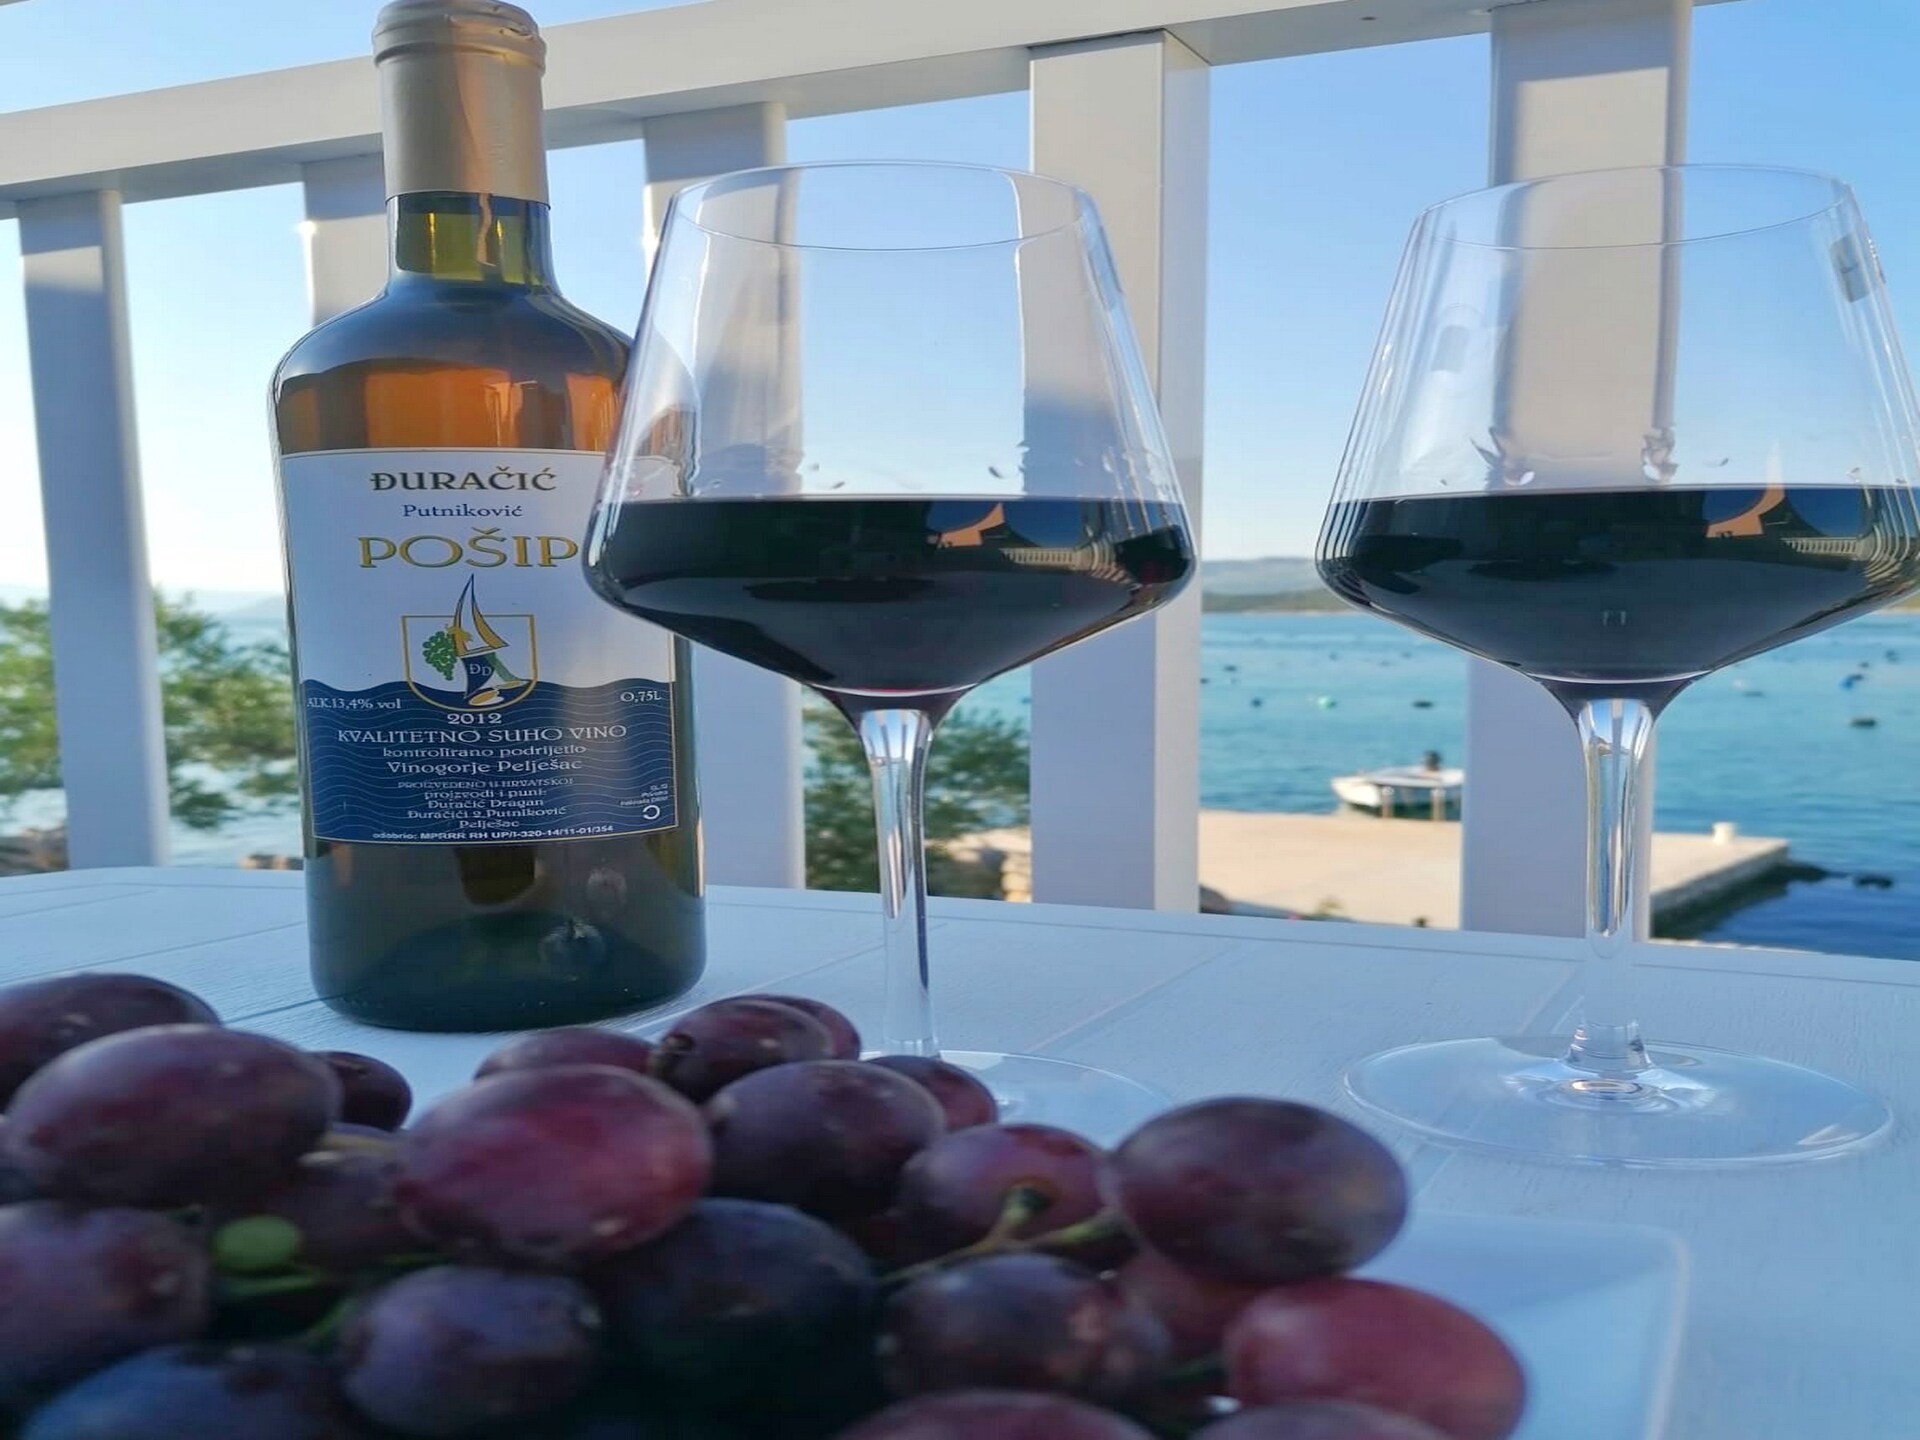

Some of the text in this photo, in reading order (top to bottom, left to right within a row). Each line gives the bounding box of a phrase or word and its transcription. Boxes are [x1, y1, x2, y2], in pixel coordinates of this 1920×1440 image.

[371, 466, 558, 491] ĐURAČIĆ
[403, 503, 523, 518] Putniković
[358, 527, 579, 568] POŠIP
[376, 698, 402, 709] vol
[447, 712, 502, 725] 2012
[338, 724, 627, 743] KVALITETNO SUHO VINO
[383, 745, 587, 758] kontrolirano podrijetlo
[386, 759, 583, 775] Vinogorje Pelješac
[398, 781, 486, 789] PROIZVEDENO
[424, 789, 494, 800] proizvodi
[428, 798, 544, 809] Đuračić Dragan
[486, 807, 567, 818] Putniković
[469, 832, 489, 840] RH
